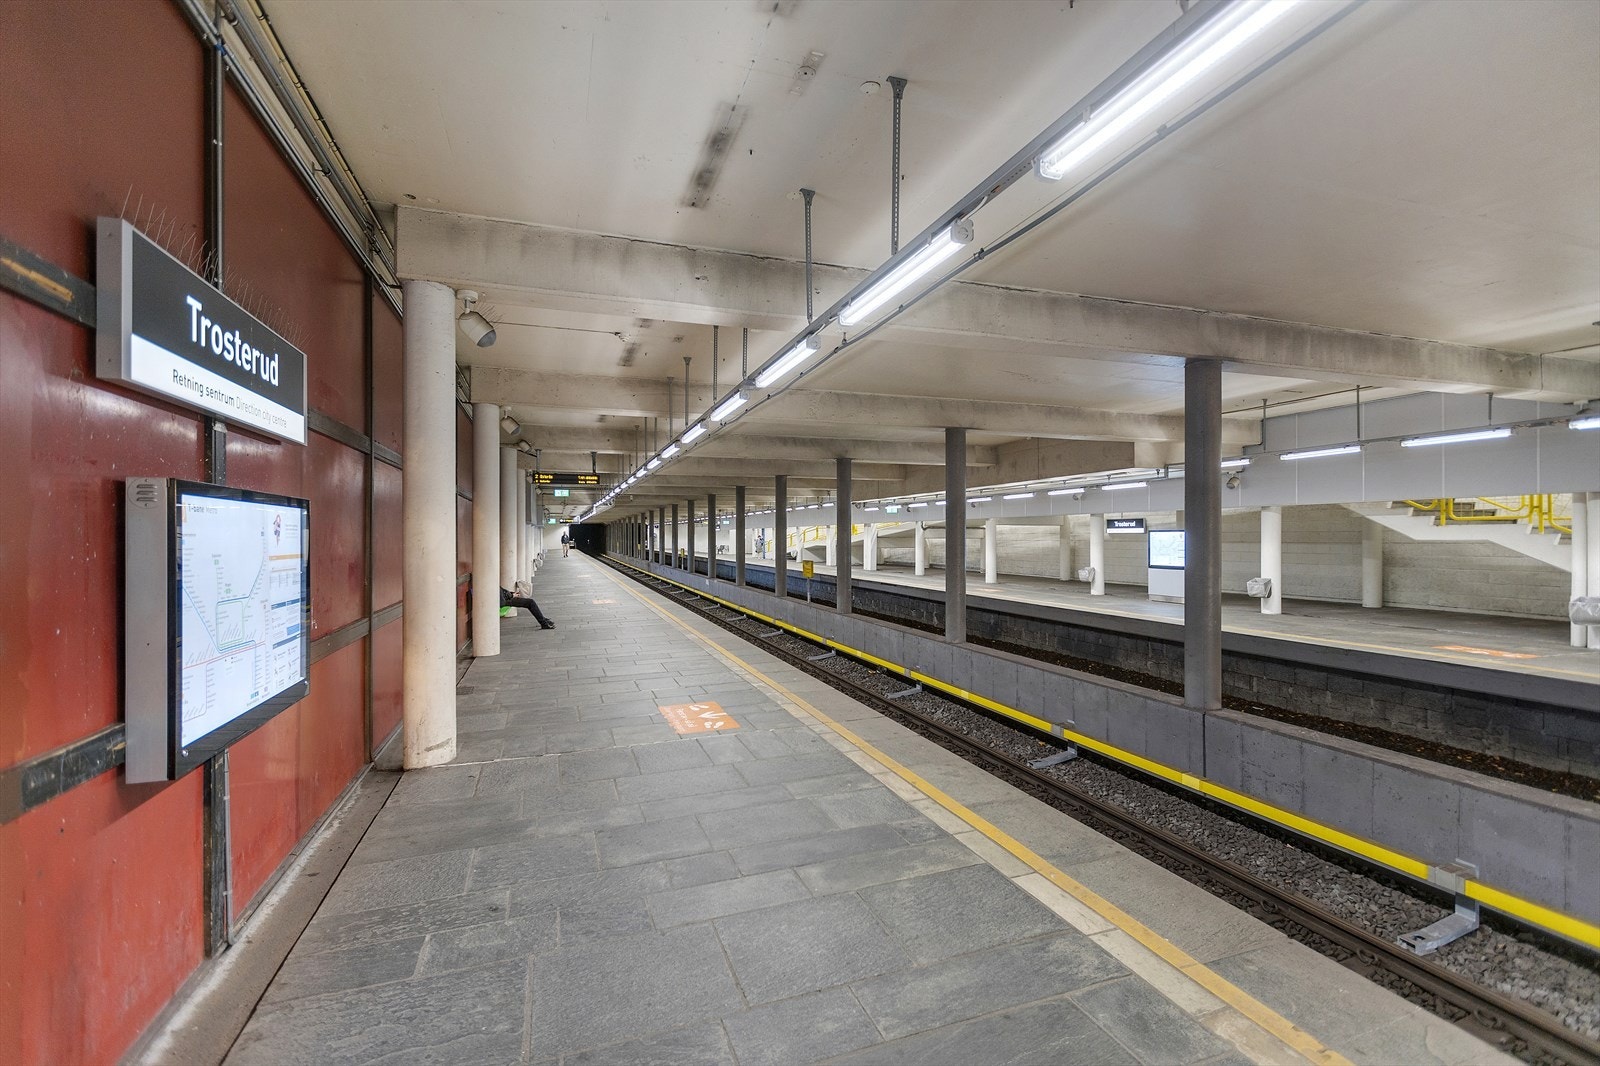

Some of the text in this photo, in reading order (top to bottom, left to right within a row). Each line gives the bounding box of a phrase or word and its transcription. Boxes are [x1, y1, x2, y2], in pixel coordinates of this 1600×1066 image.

[186, 295, 279, 387] Trosterud
[173, 369, 287, 428] Retning sentrum Direction city centre
